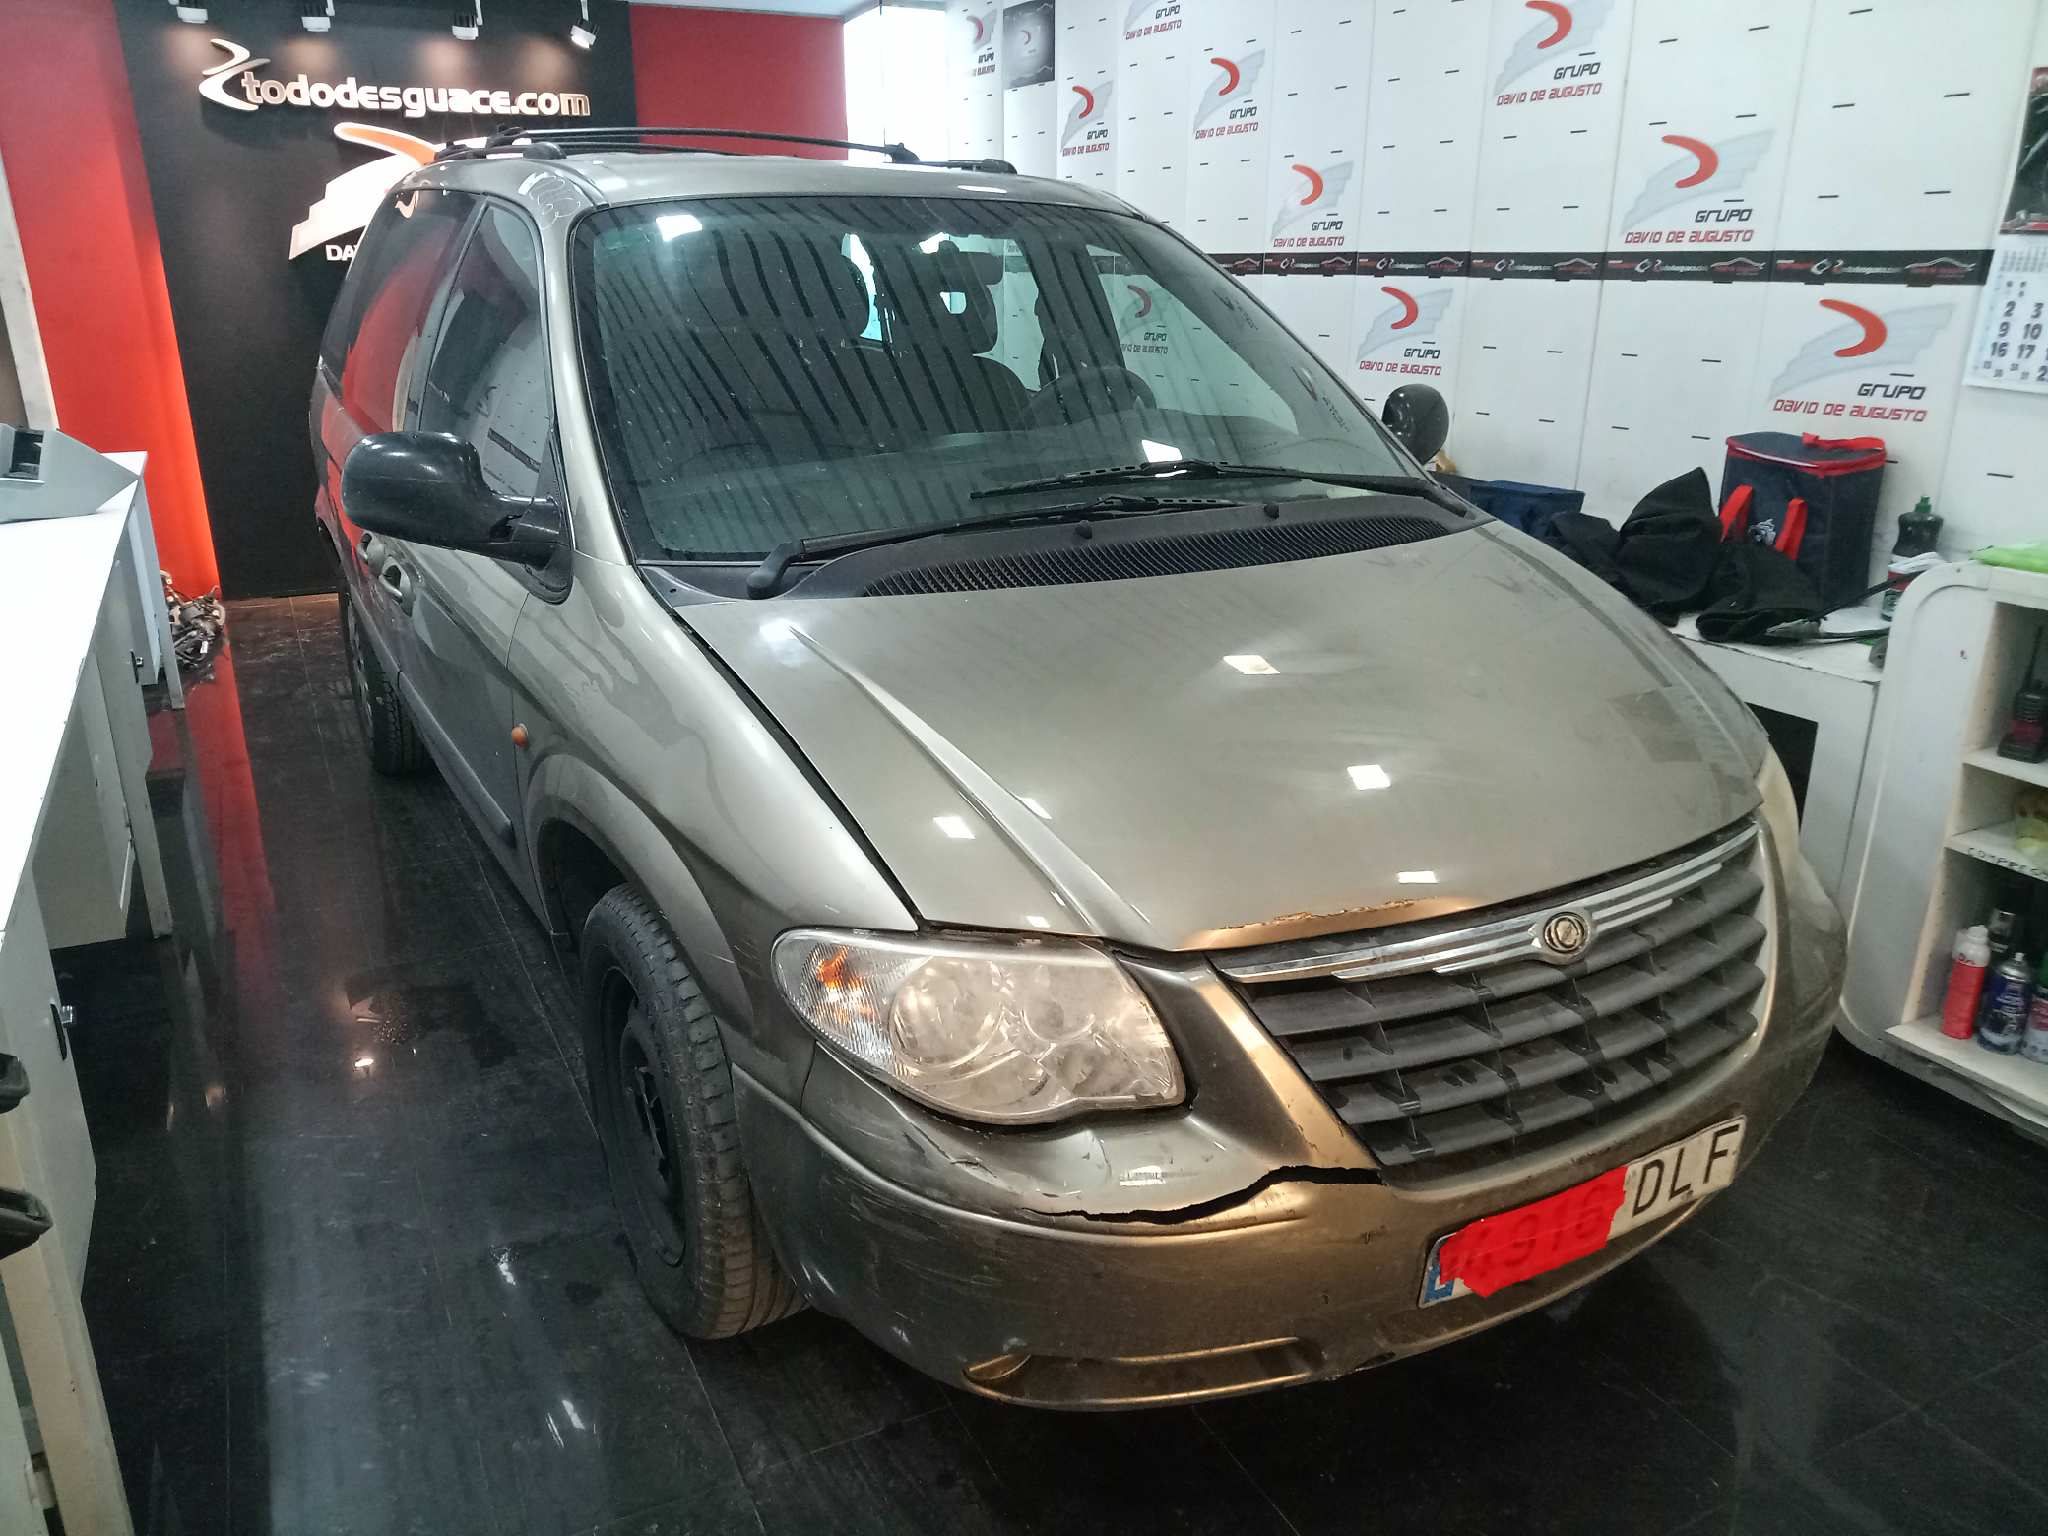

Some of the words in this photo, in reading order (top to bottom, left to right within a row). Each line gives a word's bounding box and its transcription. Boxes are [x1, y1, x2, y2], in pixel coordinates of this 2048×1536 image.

[1553, 62, 1601, 80] GRUPO
[240, 70, 592, 119] tododesguace.com
[1496, 91, 1527, 106] DAVID
[1529, 89, 1547, 102] DE
[1548, 82, 1603, 100] AUGUSTO
[1229, 106, 1258, 120] GRUPO
[1695, 208, 1753, 223] GRUPO
[1311, 220, 1344, 231] GRUPO
[1273, 238, 1295, 248] DAVID
[1295, 237, 1308, 247] DE
[1308, 236, 1345, 247] AUGUSTO
[1624, 231, 1662, 244] DAVID
[1664, 230, 1686, 243] DE
[1687, 229, 1754, 243] AUGUSTO
[2004, 300, 2016, 317] 2
[2030, 302, 2044, 319] 3
[1998, 321, 2010, 337] 9
[2023, 323, 2042, 340] 10
[1403, 347, 1441, 359] GRUPO
[1991, 342, 2009, 358] 16
[2017, 343, 2037, 360] 17
[1360, 360, 1383, 372] DAVID
[1384, 362, 1398, 373] DE
[1399, 363, 1442, 376] AUGUSTO
[1857, 382, 1927, 401] GRUPO
[1773, 399, 1819, 415] DAVID
[1823, 403, 1846, 417] DE
[1849, 405, 1928, 423] AUGUSTO
[1631, 1123, 1740, 1218] DLF
